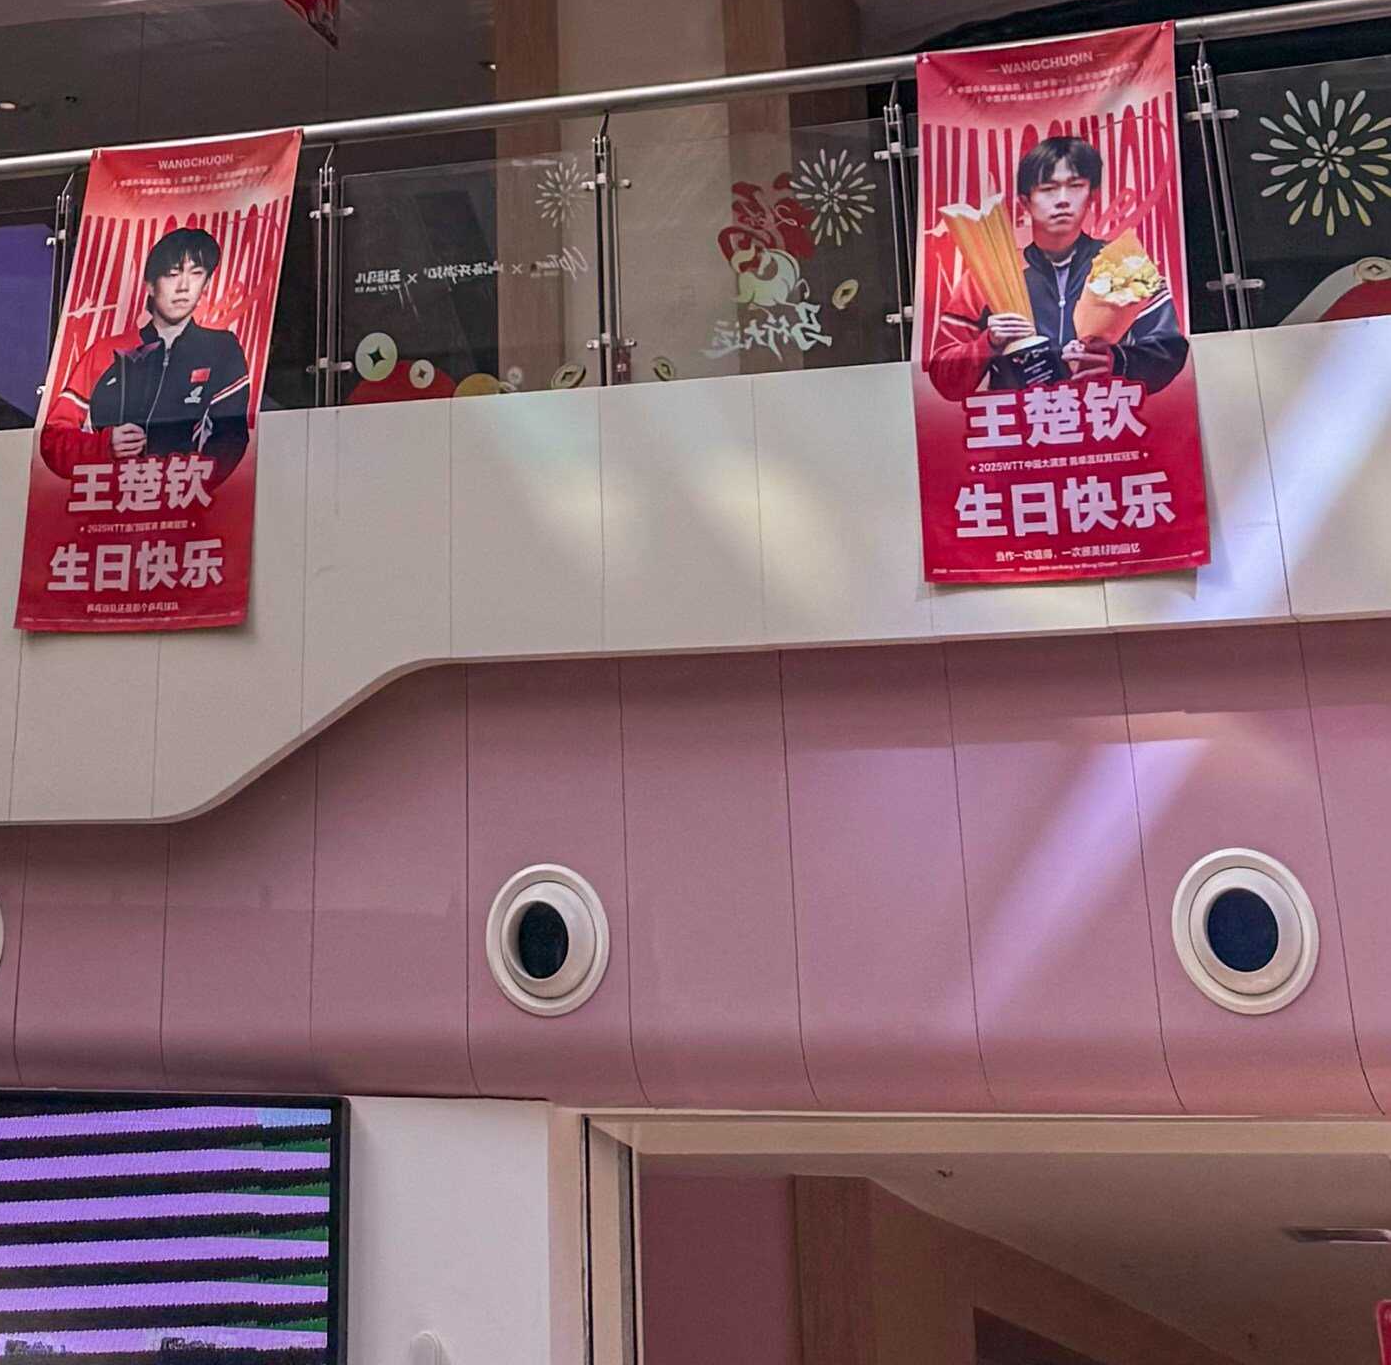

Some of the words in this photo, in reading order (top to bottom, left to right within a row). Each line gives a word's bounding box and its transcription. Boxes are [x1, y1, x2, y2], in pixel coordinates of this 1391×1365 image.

[1000, 51, 1094, 75] WANGCHUQIN
[158, 154, 234, 170] WANGCHUQIN
[965, 380, 1147, 450] 王楚钦
[68, 455, 215, 513] 王楚钦
[954, 471, 1176, 538] 生日快乐
[47, 538, 223, 592] 生日快乐
